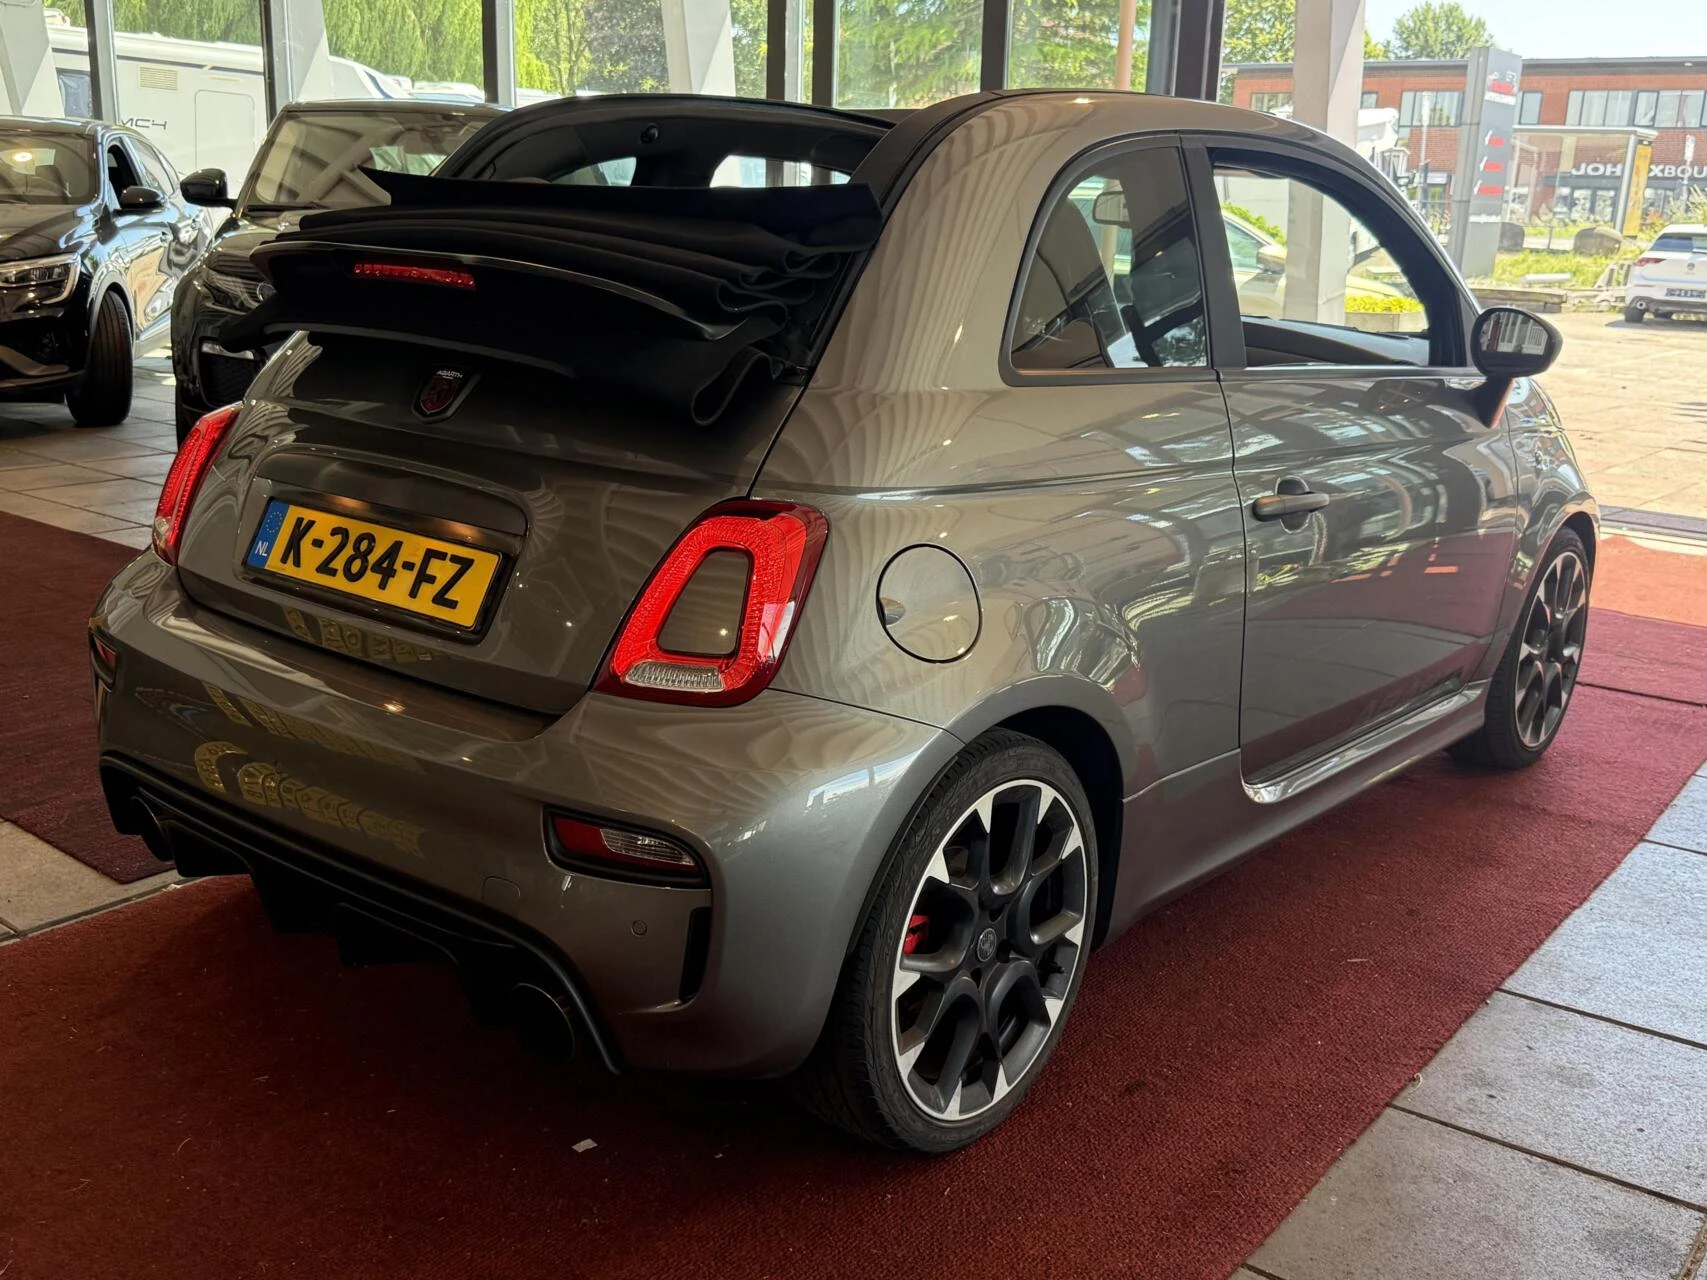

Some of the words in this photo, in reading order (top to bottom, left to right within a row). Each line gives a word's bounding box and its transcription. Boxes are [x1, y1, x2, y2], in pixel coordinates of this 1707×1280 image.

[1571, 162, 1623, 176] JOH
[255, 540, 268, 558] NL
[280, 516, 475, 610] K-284-FZ
